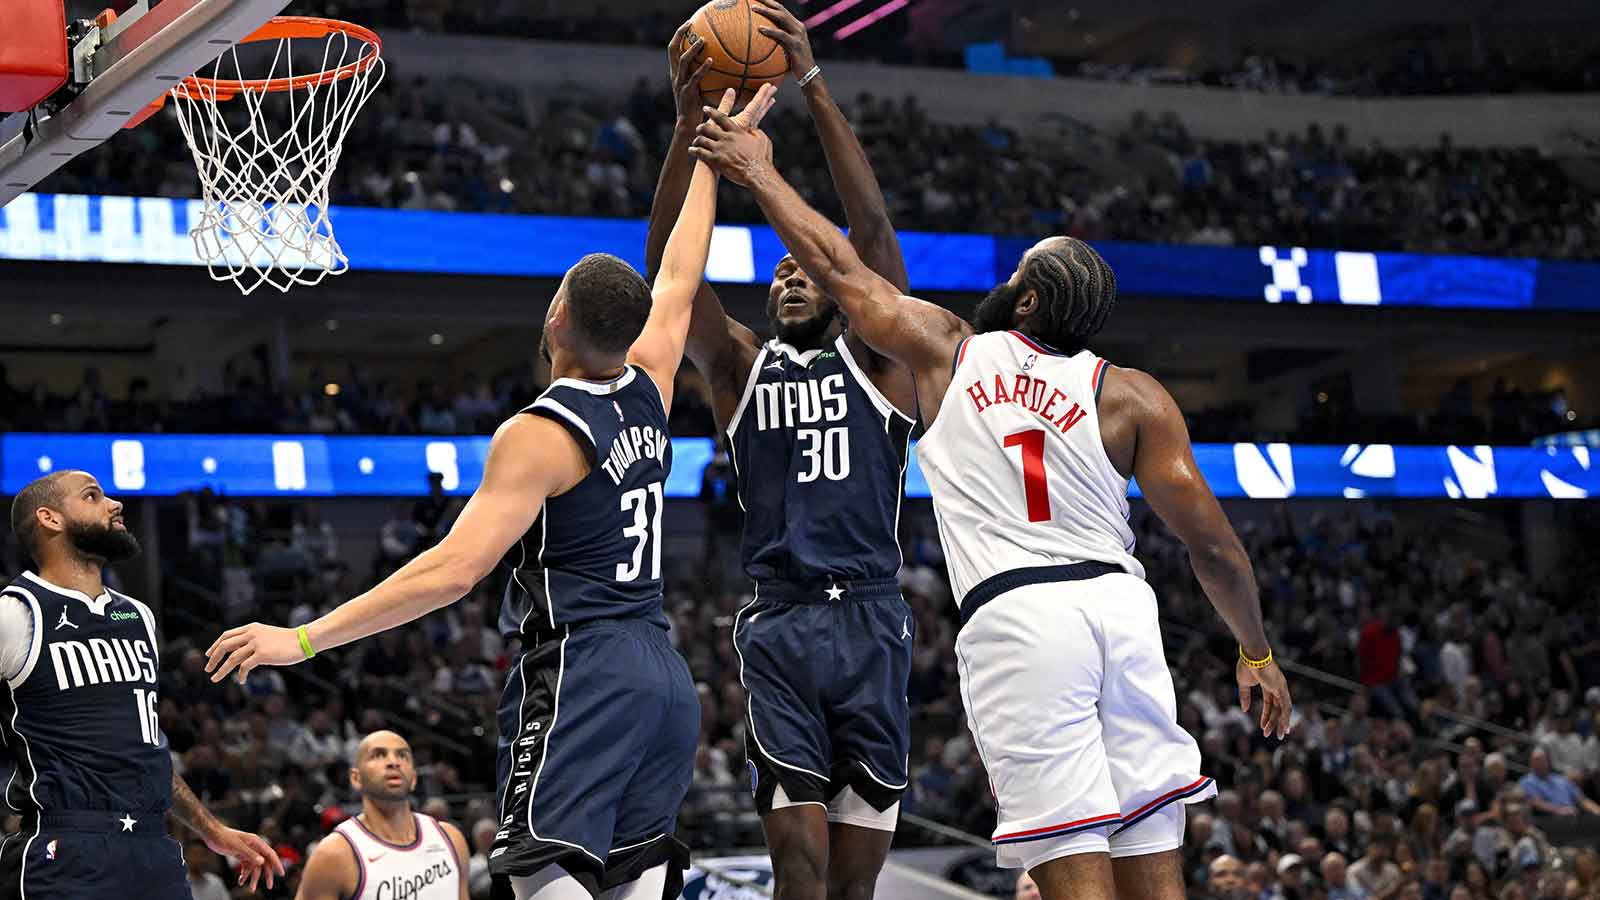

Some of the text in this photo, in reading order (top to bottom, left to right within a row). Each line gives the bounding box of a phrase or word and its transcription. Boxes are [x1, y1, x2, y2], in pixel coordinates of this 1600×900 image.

[966, 374, 1088, 434] HARDEN
[797, 426, 850, 483] 30
[1003, 429, 1052, 523] 1
[615, 481, 664, 583] 31
[110, 610, 139, 622] chime
[48, 638, 157, 691] MAVS
[133, 688, 160, 747] 16
[376, 857, 452, 900] Clippers
